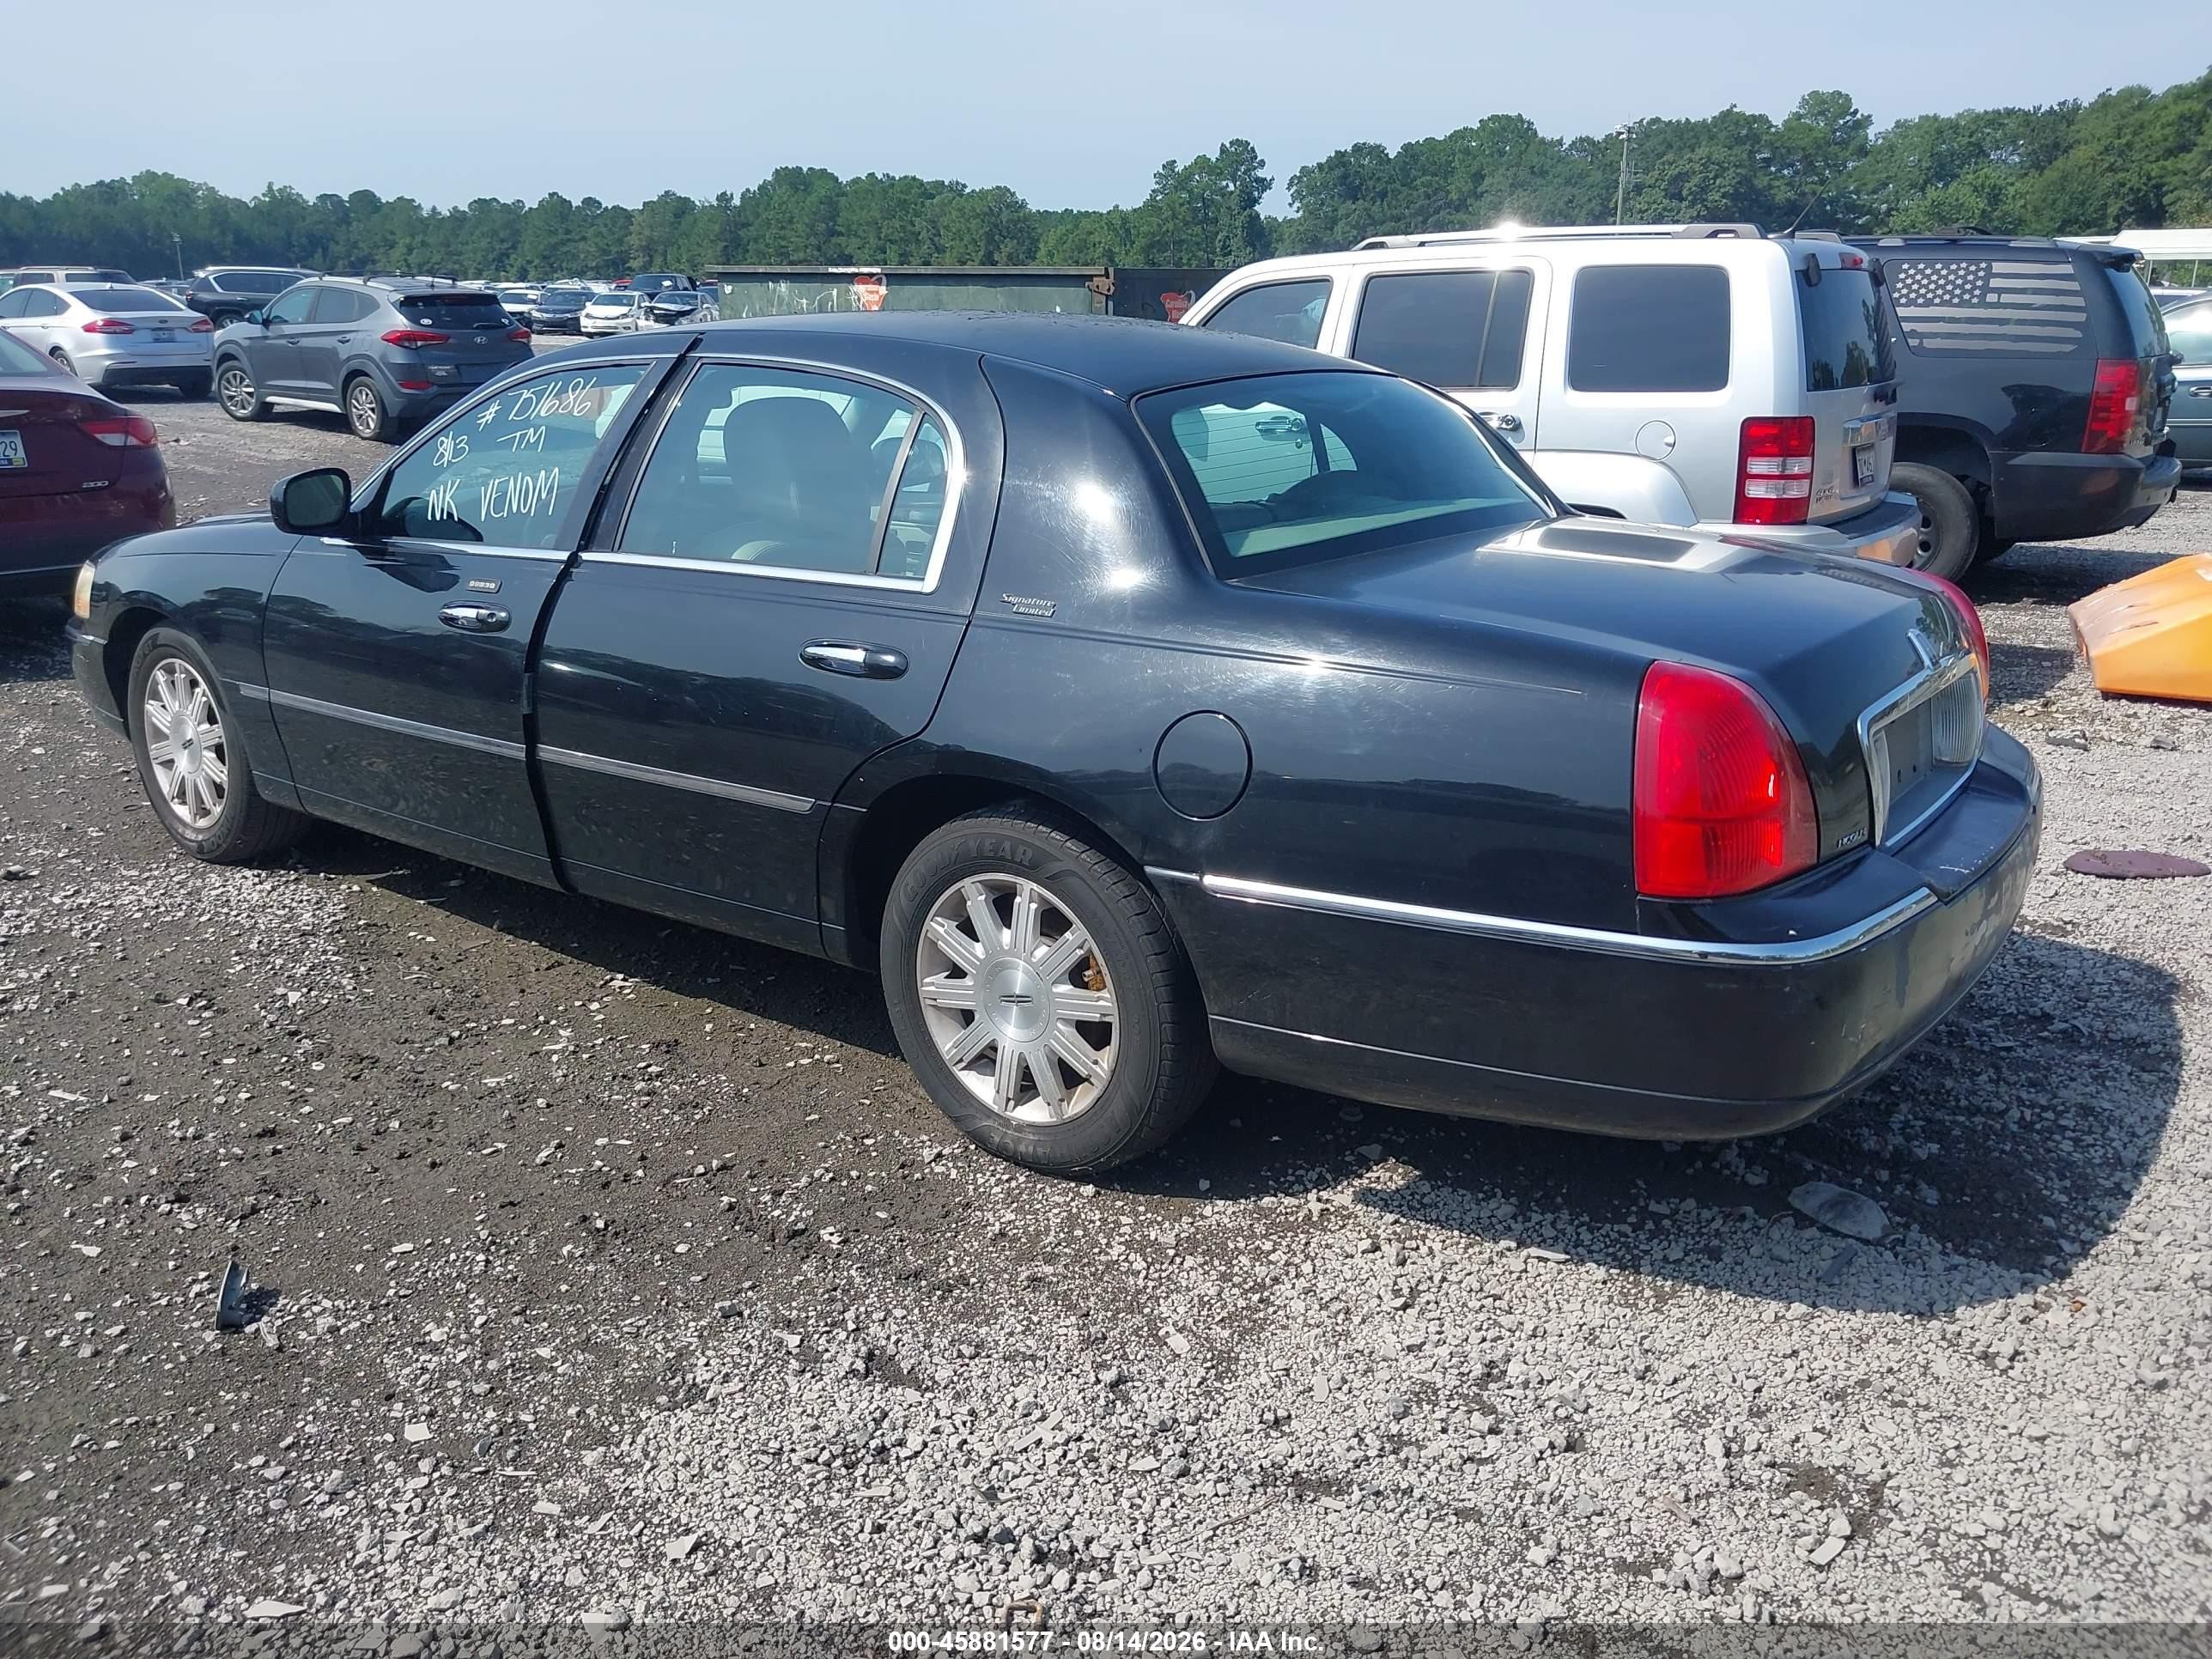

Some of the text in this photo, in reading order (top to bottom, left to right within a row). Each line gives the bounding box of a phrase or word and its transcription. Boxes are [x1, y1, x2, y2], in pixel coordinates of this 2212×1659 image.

[477, 400, 502, 431] #
[495, 425, 546, 453] TM
[427, 467, 560, 522] NK VENOM
[1000, 592, 1056, 608] Signature
[1012, 604, 1055, 617] Limited
